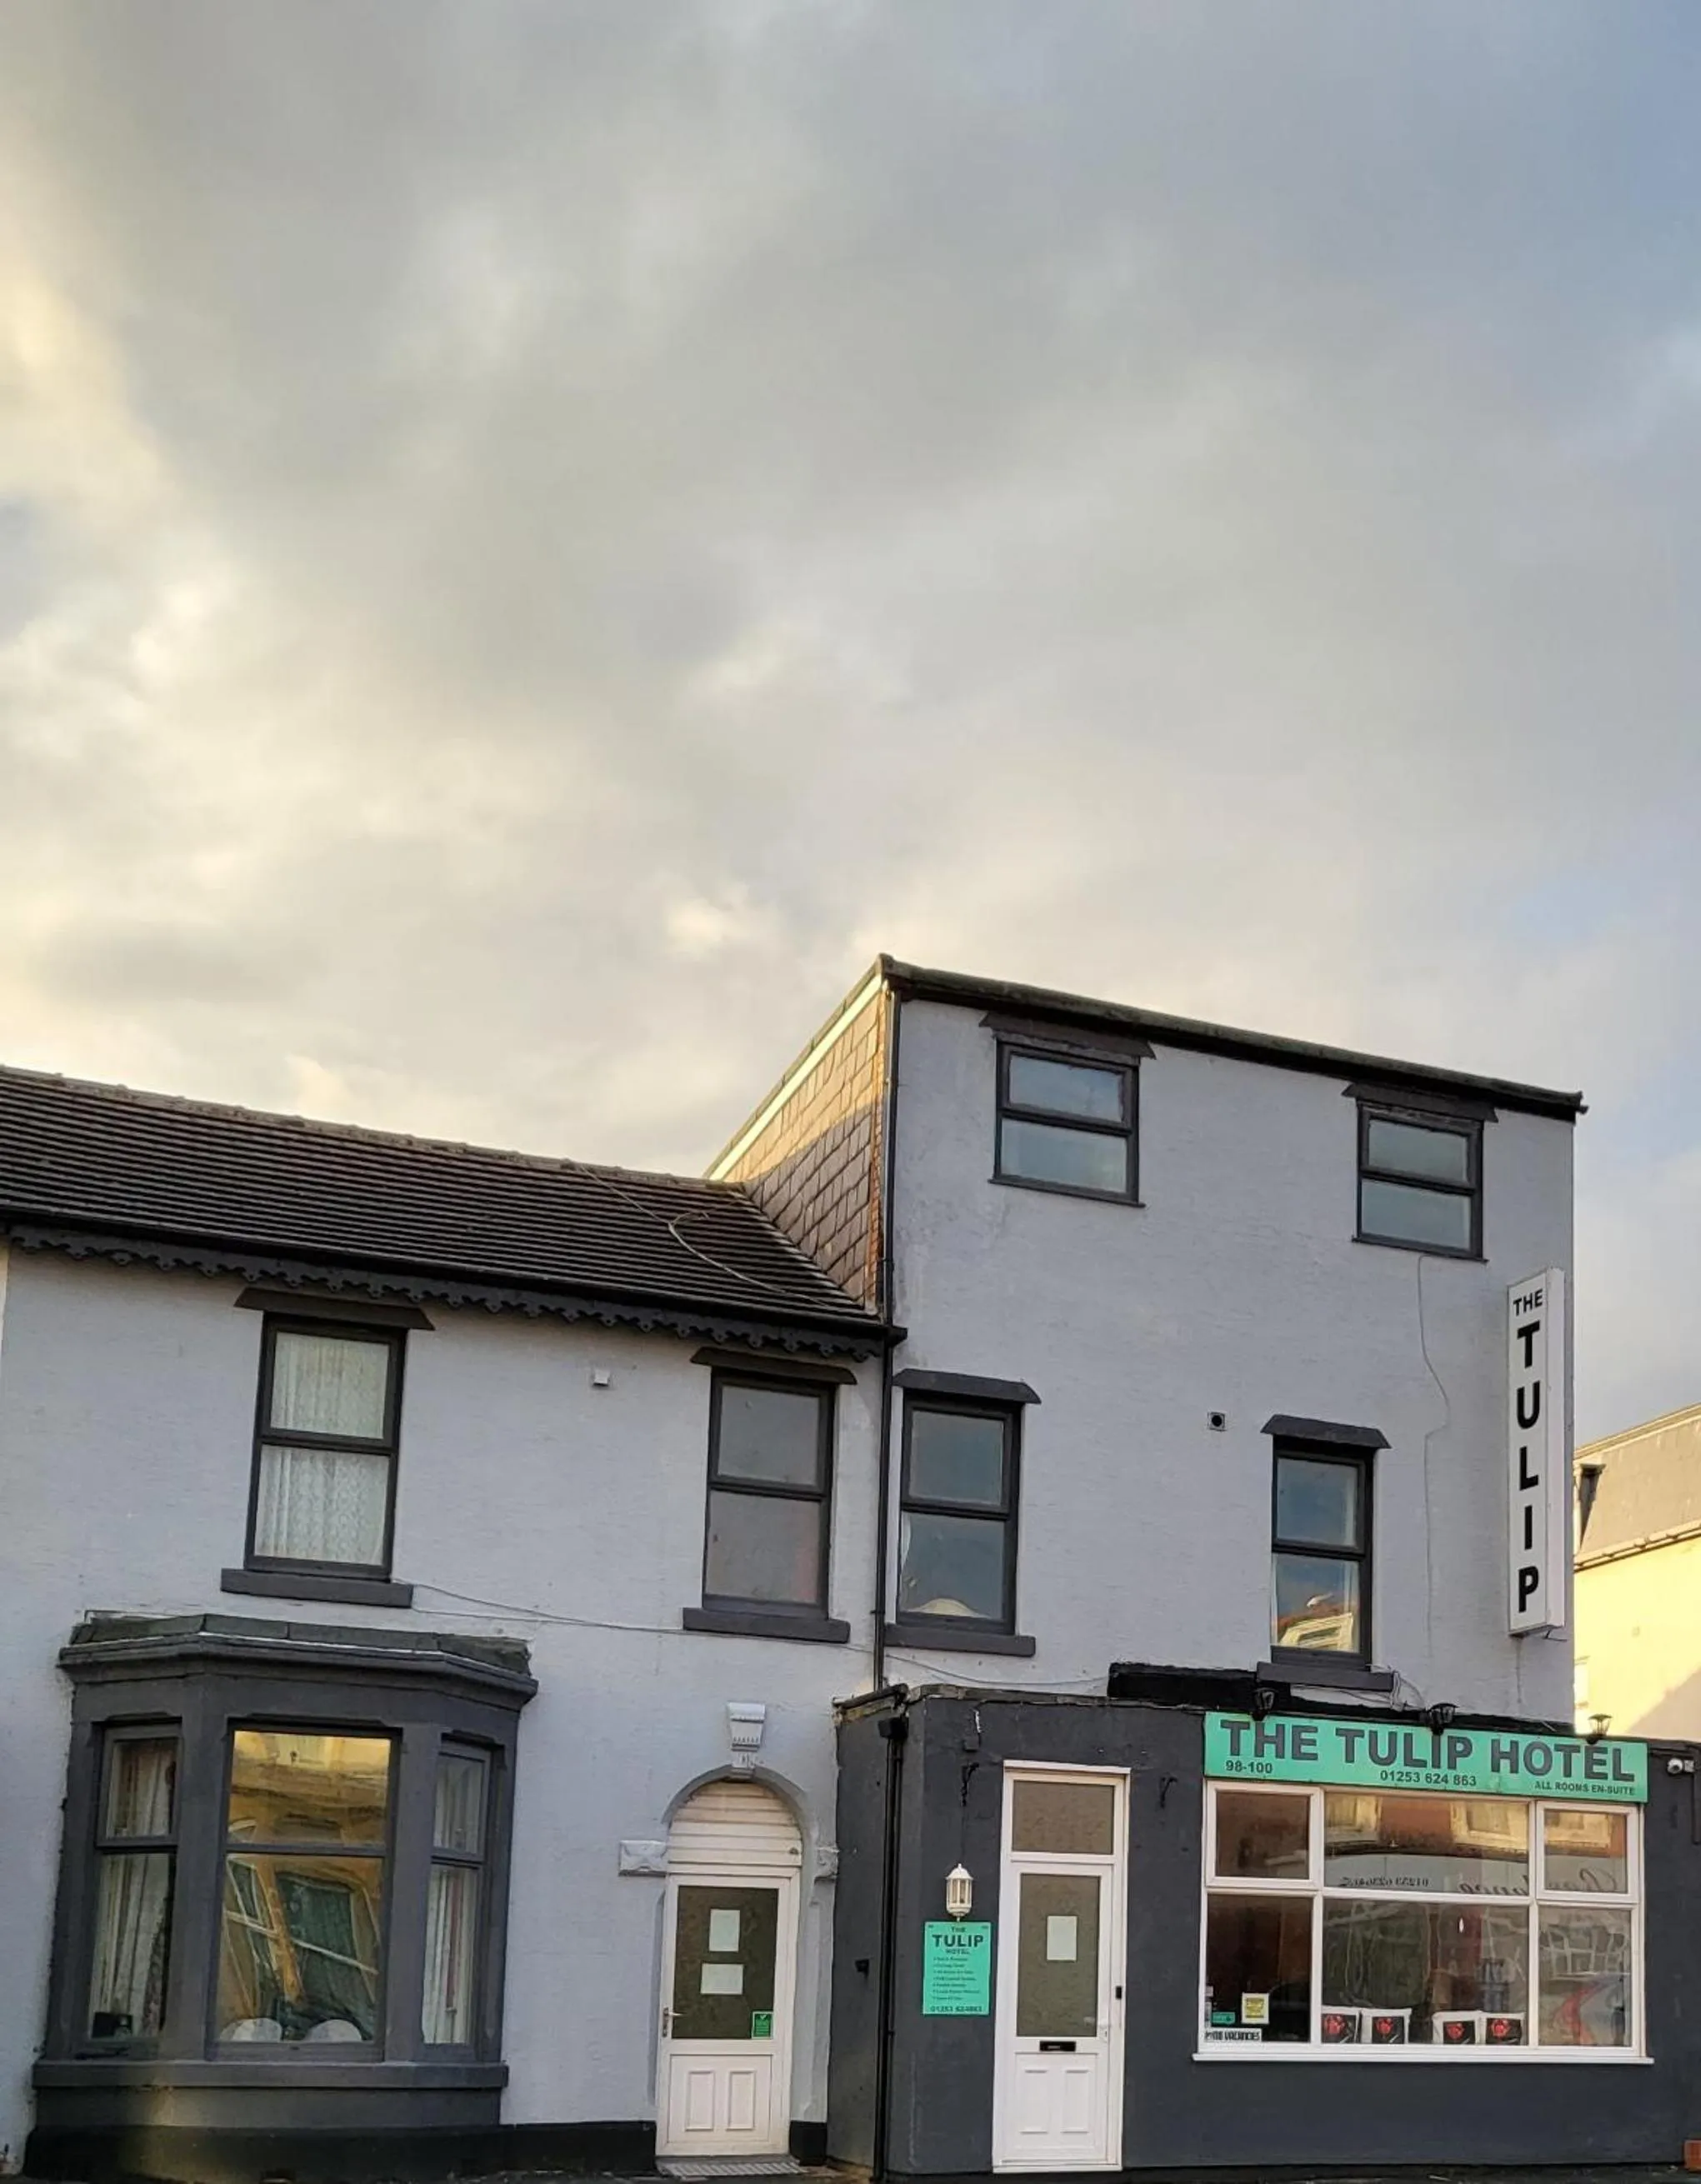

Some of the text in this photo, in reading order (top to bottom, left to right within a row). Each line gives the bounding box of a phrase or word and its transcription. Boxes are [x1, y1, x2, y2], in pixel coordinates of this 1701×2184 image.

[1513, 1289, 1543, 1317] THE
[1516, 1321, 1540, 1612] TULIP
[1220, 1718, 1635, 1782] THE TULIP HOTEL
[1226, 1760, 1273, 1775] 98-100
[1379, 1769, 1478, 1787] 01253 624 863
[1534, 1781, 1636, 1796] ALL ROOMS EN-SUITE
[932, 1934, 984, 1947] TULIP
